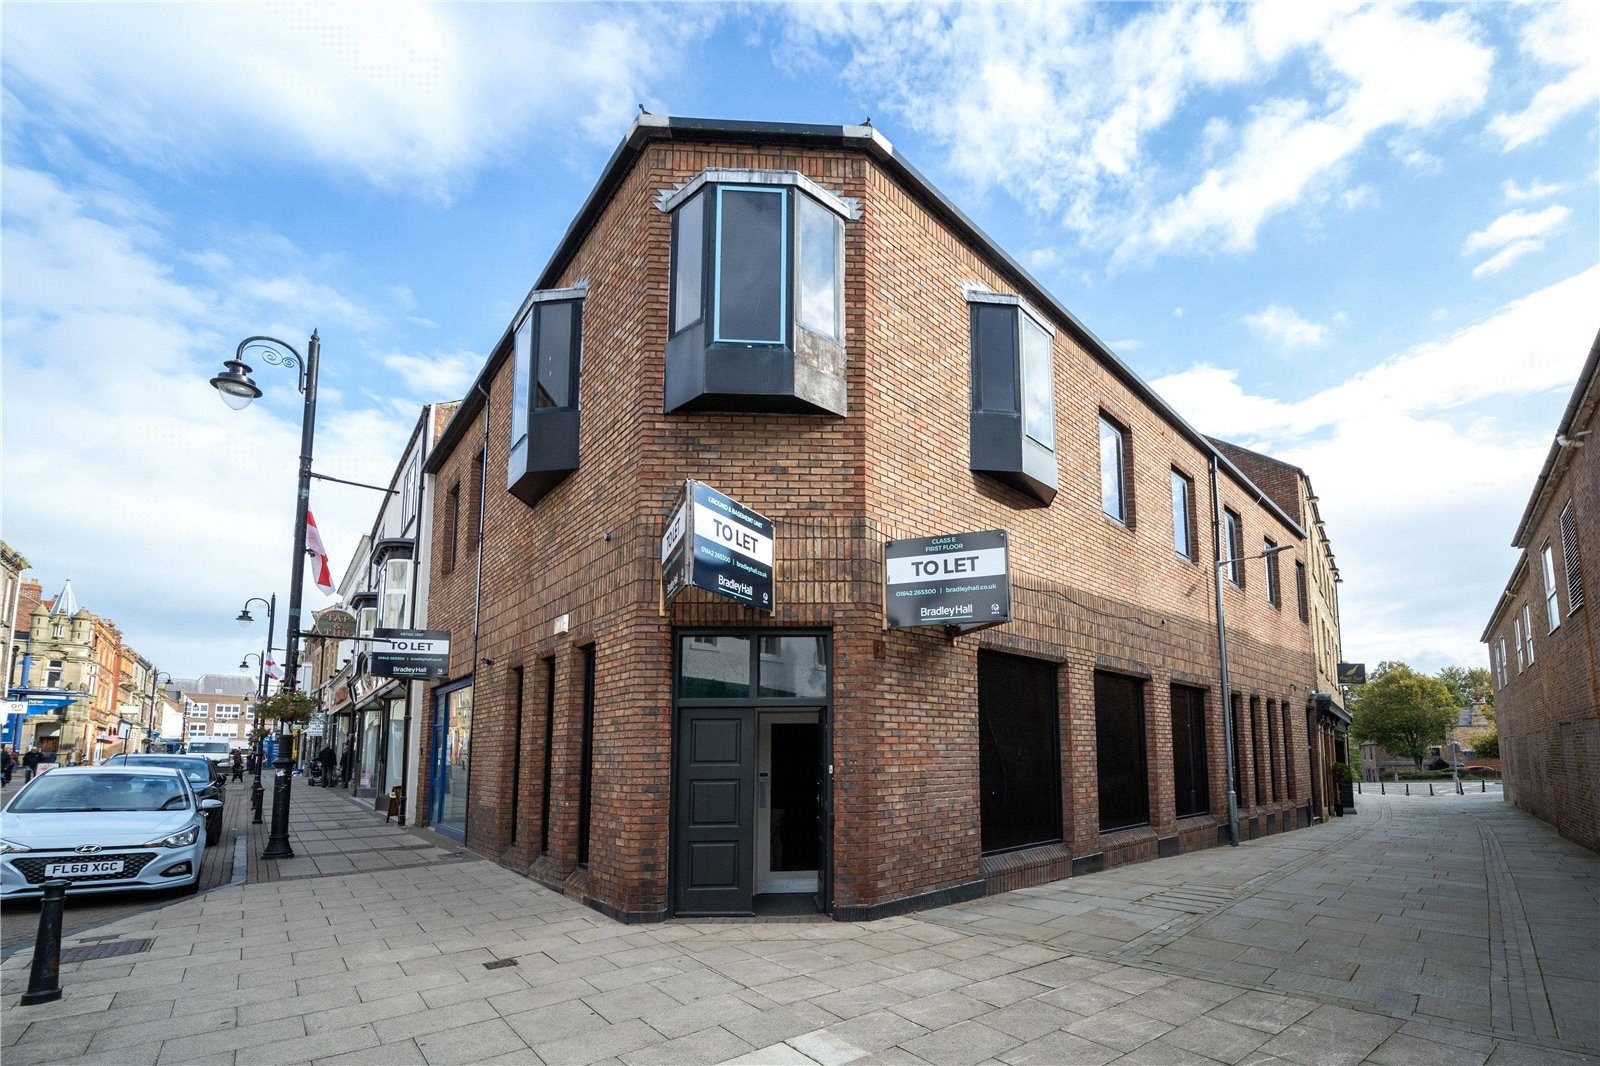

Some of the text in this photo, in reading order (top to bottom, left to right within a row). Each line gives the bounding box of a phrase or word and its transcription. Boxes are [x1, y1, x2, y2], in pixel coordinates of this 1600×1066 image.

[708, 496, 728, 511] GROUND
[732, 506, 754, 524] BASEMENT
[754, 520, 763, 529] UNIT
[672, 518, 680, 542] LET
[713, 518, 758, 554] TO LET
[911, 556, 980, 576] TO LET
[896, 584, 997, 597] 01642 265300 bradleyhall.co.uk
[920, 604, 973, 618] Bradley Hall
[326, 614, 350, 622] TAP
[324, 627, 350, 638] TUN
[390, 641, 434, 651] TO LET
[52, 862, 118, 874] FL68 XGC
